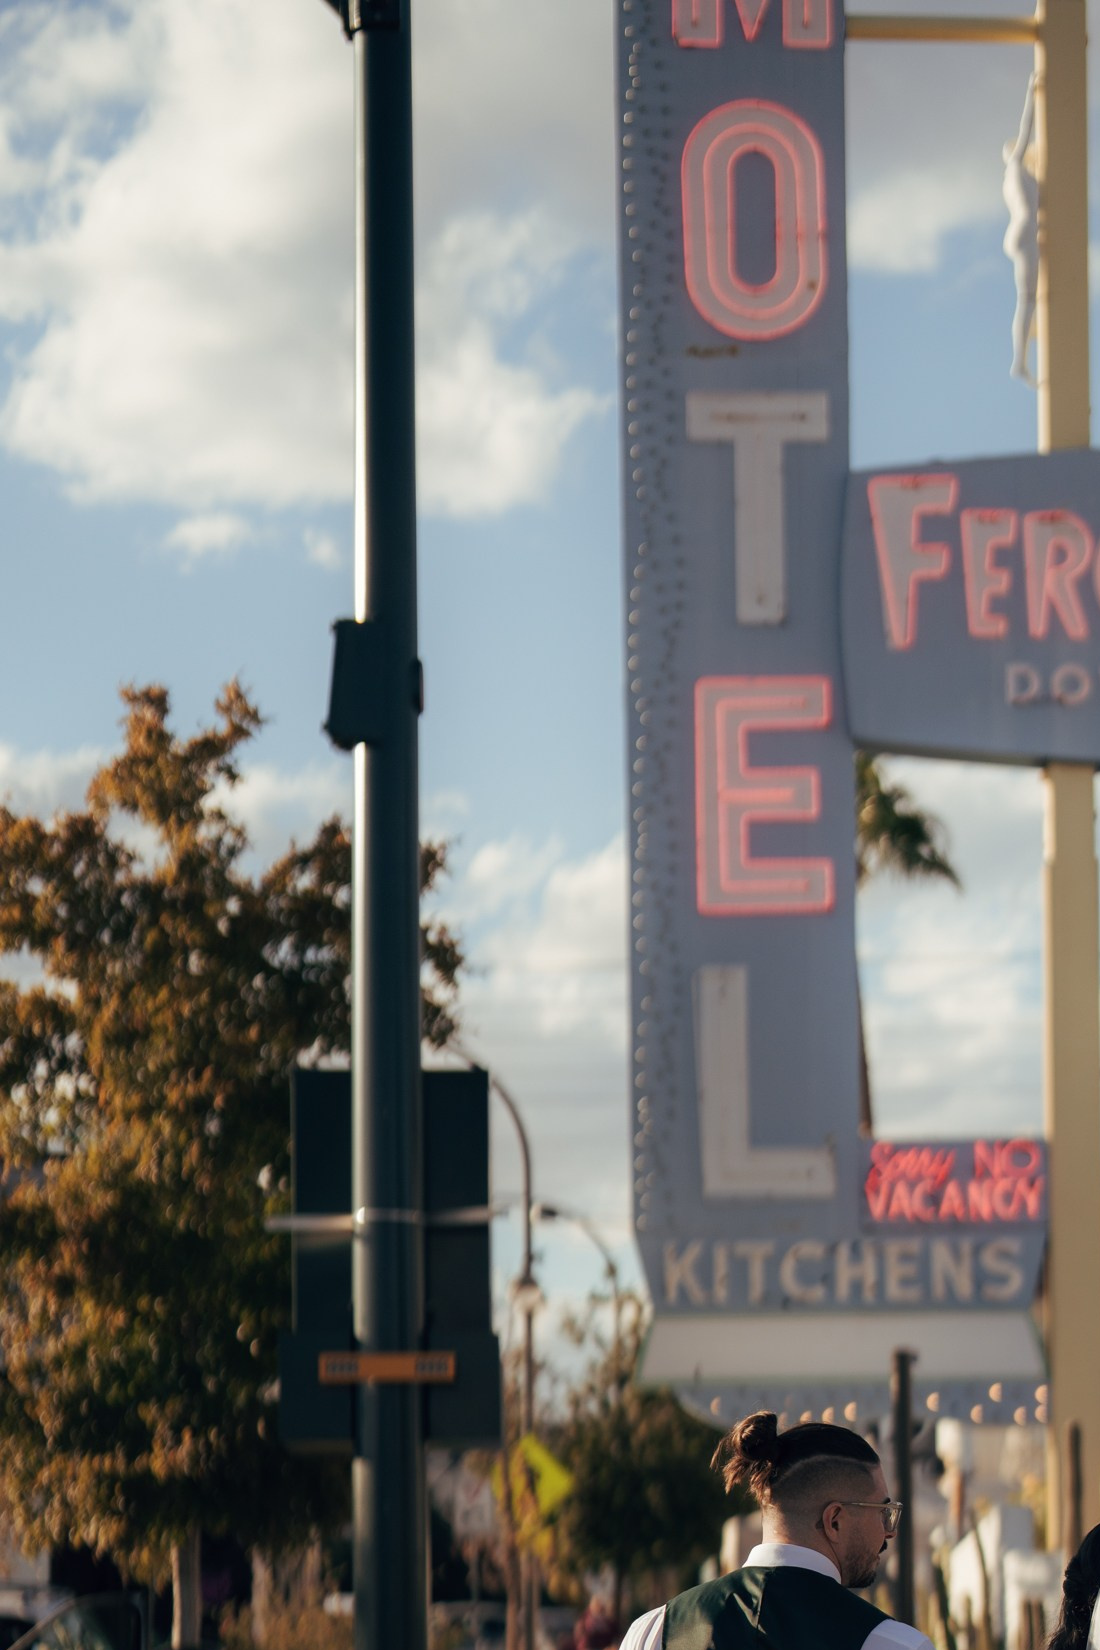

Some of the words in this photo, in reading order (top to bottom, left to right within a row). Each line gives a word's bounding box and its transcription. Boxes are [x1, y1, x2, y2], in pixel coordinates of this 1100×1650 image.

[671, 0, 837, 1197] OTEL
[973, 1138, 1041, 1179] NO
[865, 1177, 1043, 1223] VACANCY
[663, 1235, 1024, 1305] KITCHENS
